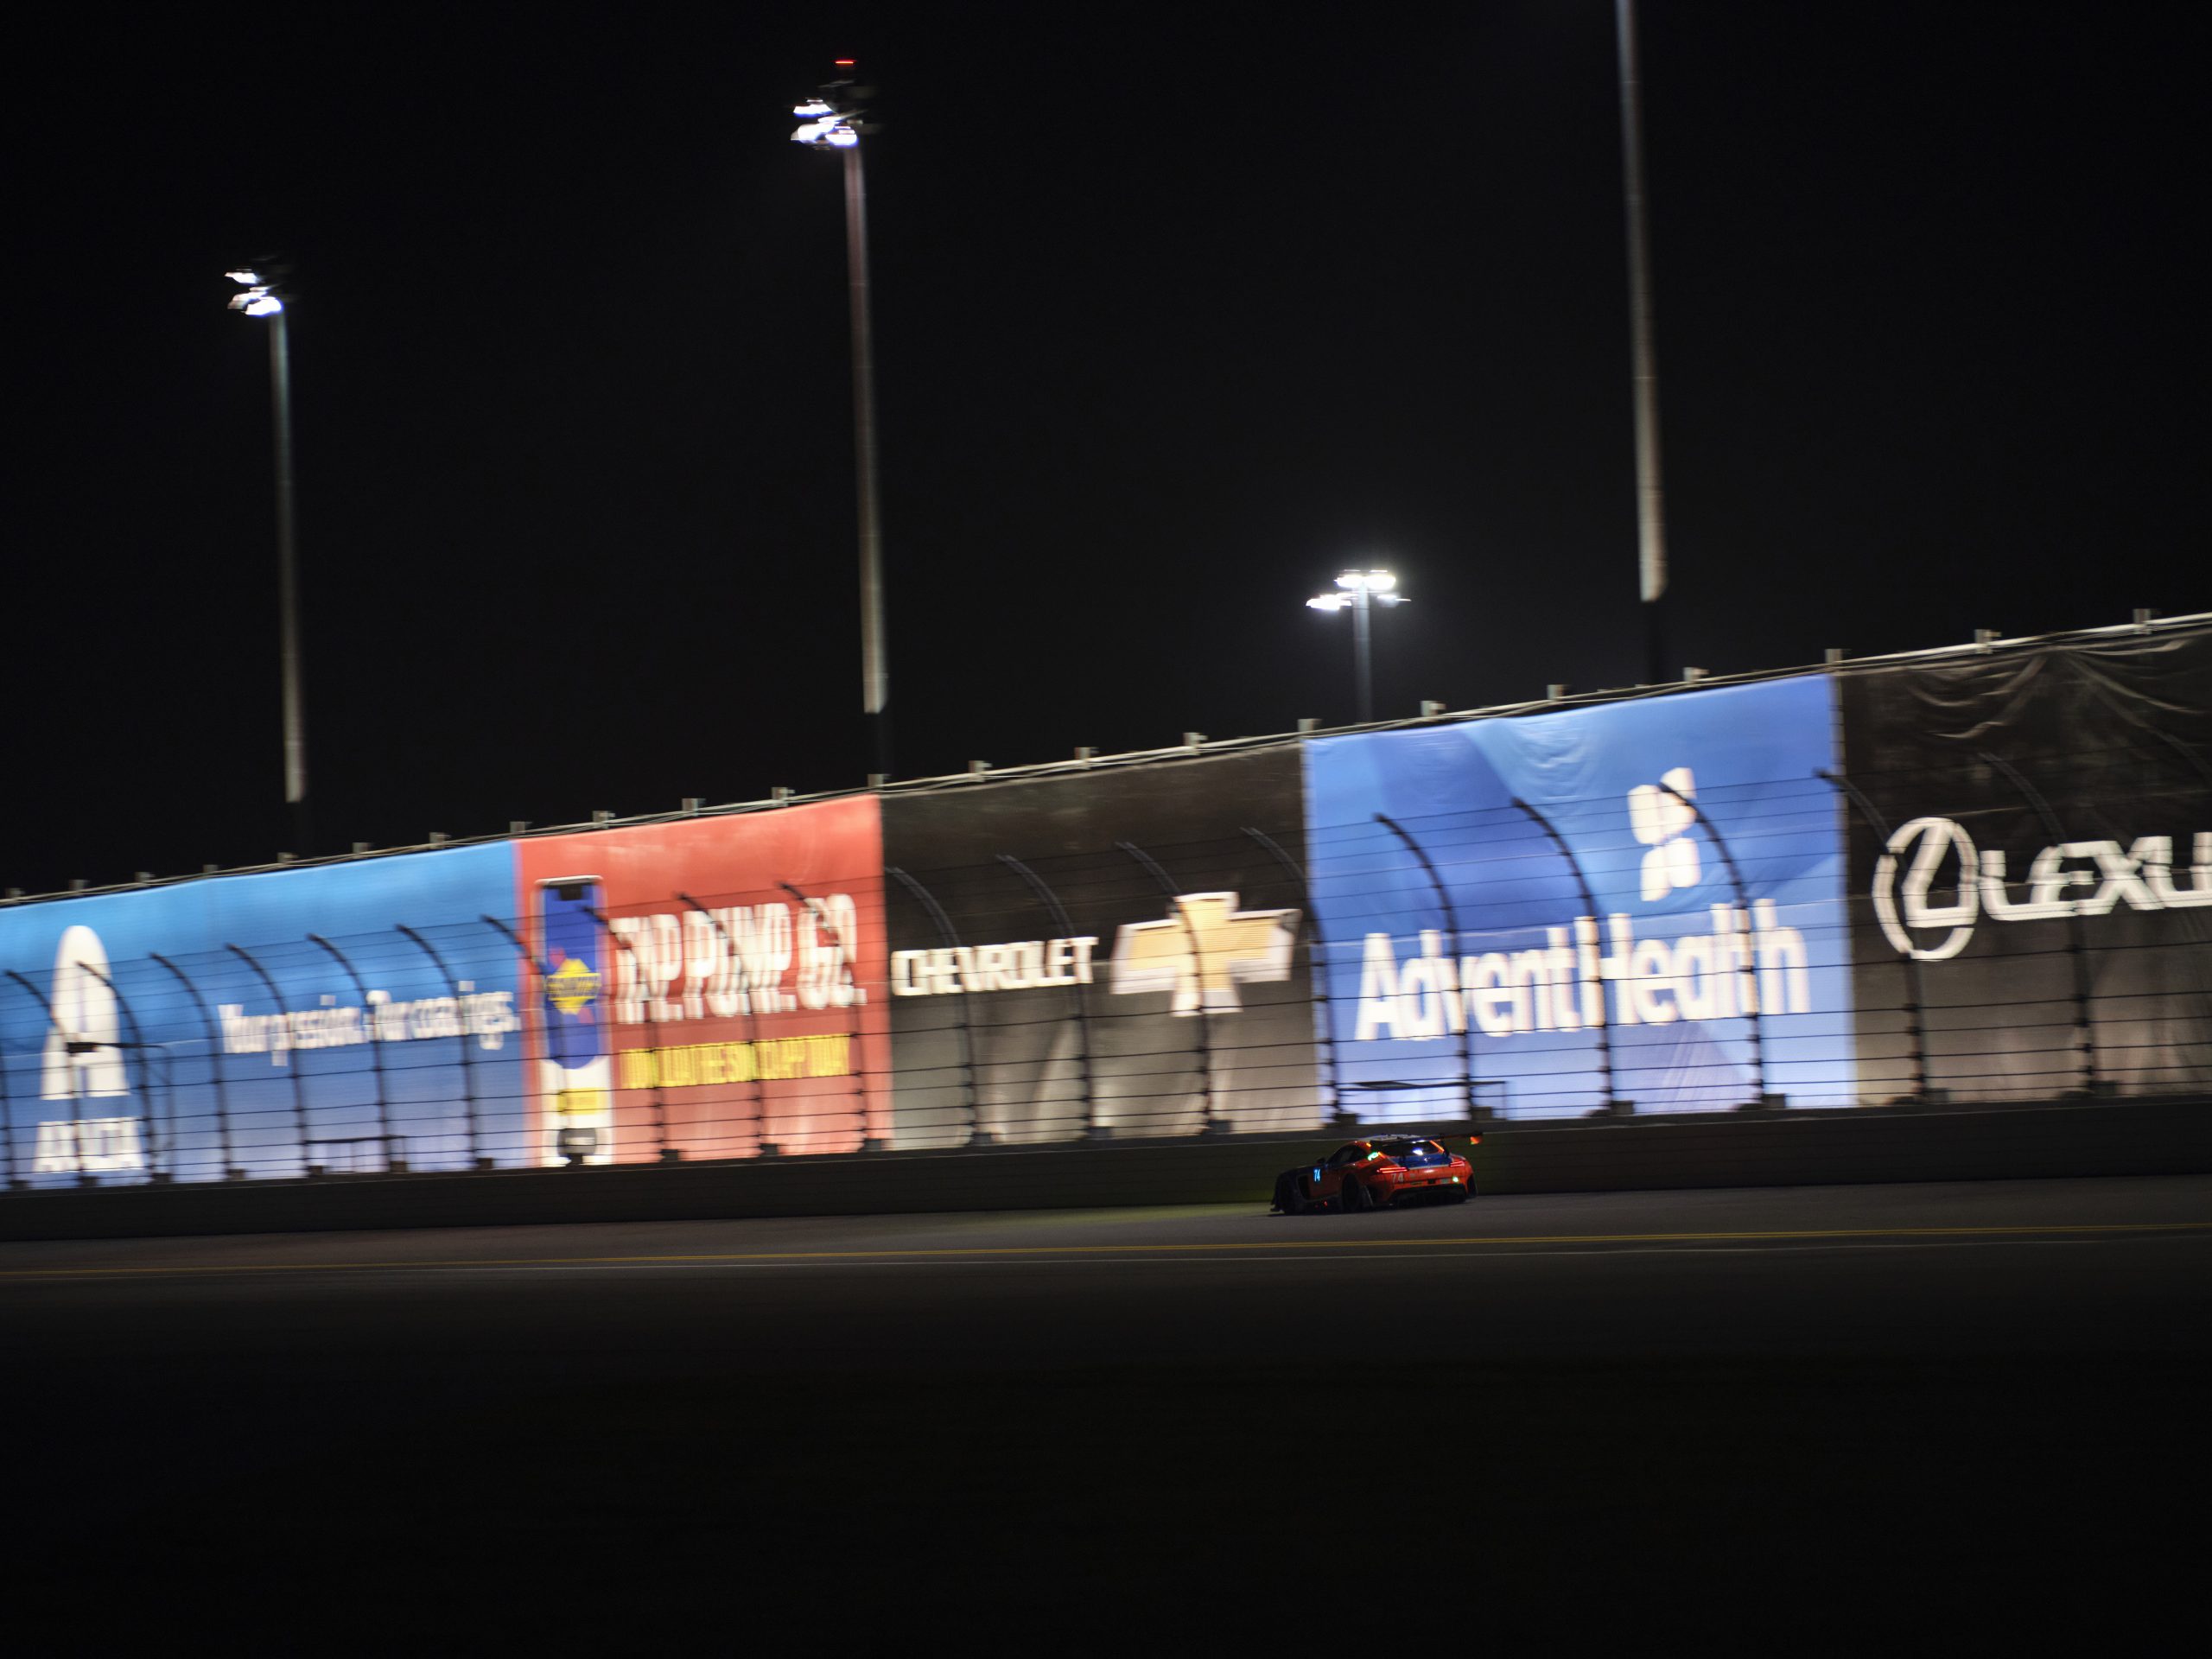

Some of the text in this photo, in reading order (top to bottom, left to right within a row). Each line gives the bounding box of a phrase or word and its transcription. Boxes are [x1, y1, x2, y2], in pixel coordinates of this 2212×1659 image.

[892, 937, 1099, 996] CHEVROLET
[1355, 899, 1811, 1040] AdventHealth
[1313, 1168, 1321, 1183] 74
[1391, 1173, 1404, 1183] 74
